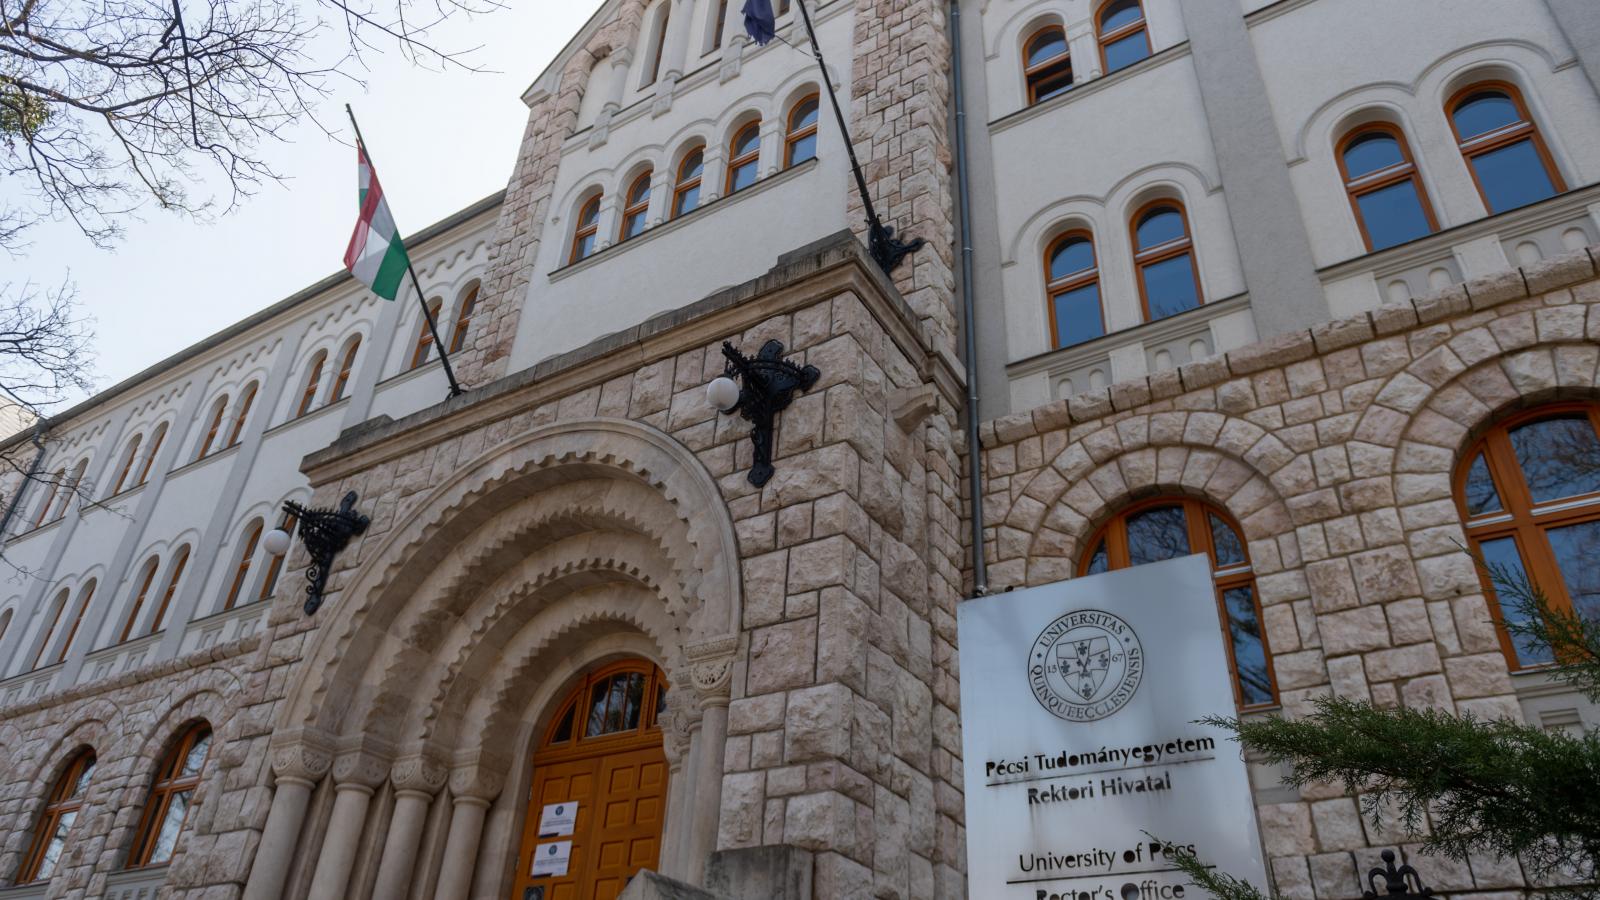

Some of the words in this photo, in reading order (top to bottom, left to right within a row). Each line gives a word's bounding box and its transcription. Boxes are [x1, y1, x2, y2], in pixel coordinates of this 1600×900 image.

[1040, 613, 1125, 647] UNIVERSITAS
[1047, 664, 1057, 674] 15
[1112, 653, 1123, 662] 67
[1031, 648, 1140, 719] QUINQUEECCLESIENSIS
[986, 756, 1029, 777] Pécsi
[1035, 736, 1215, 770] Tudományegyetem
[1028, 781, 1094, 805] Rektori
[1101, 771, 1172, 797] Hivatal
[1019, 848, 1116, 872] University
[1123, 842, 1142, 863] of
[1120, 880, 1185, 900] Office
